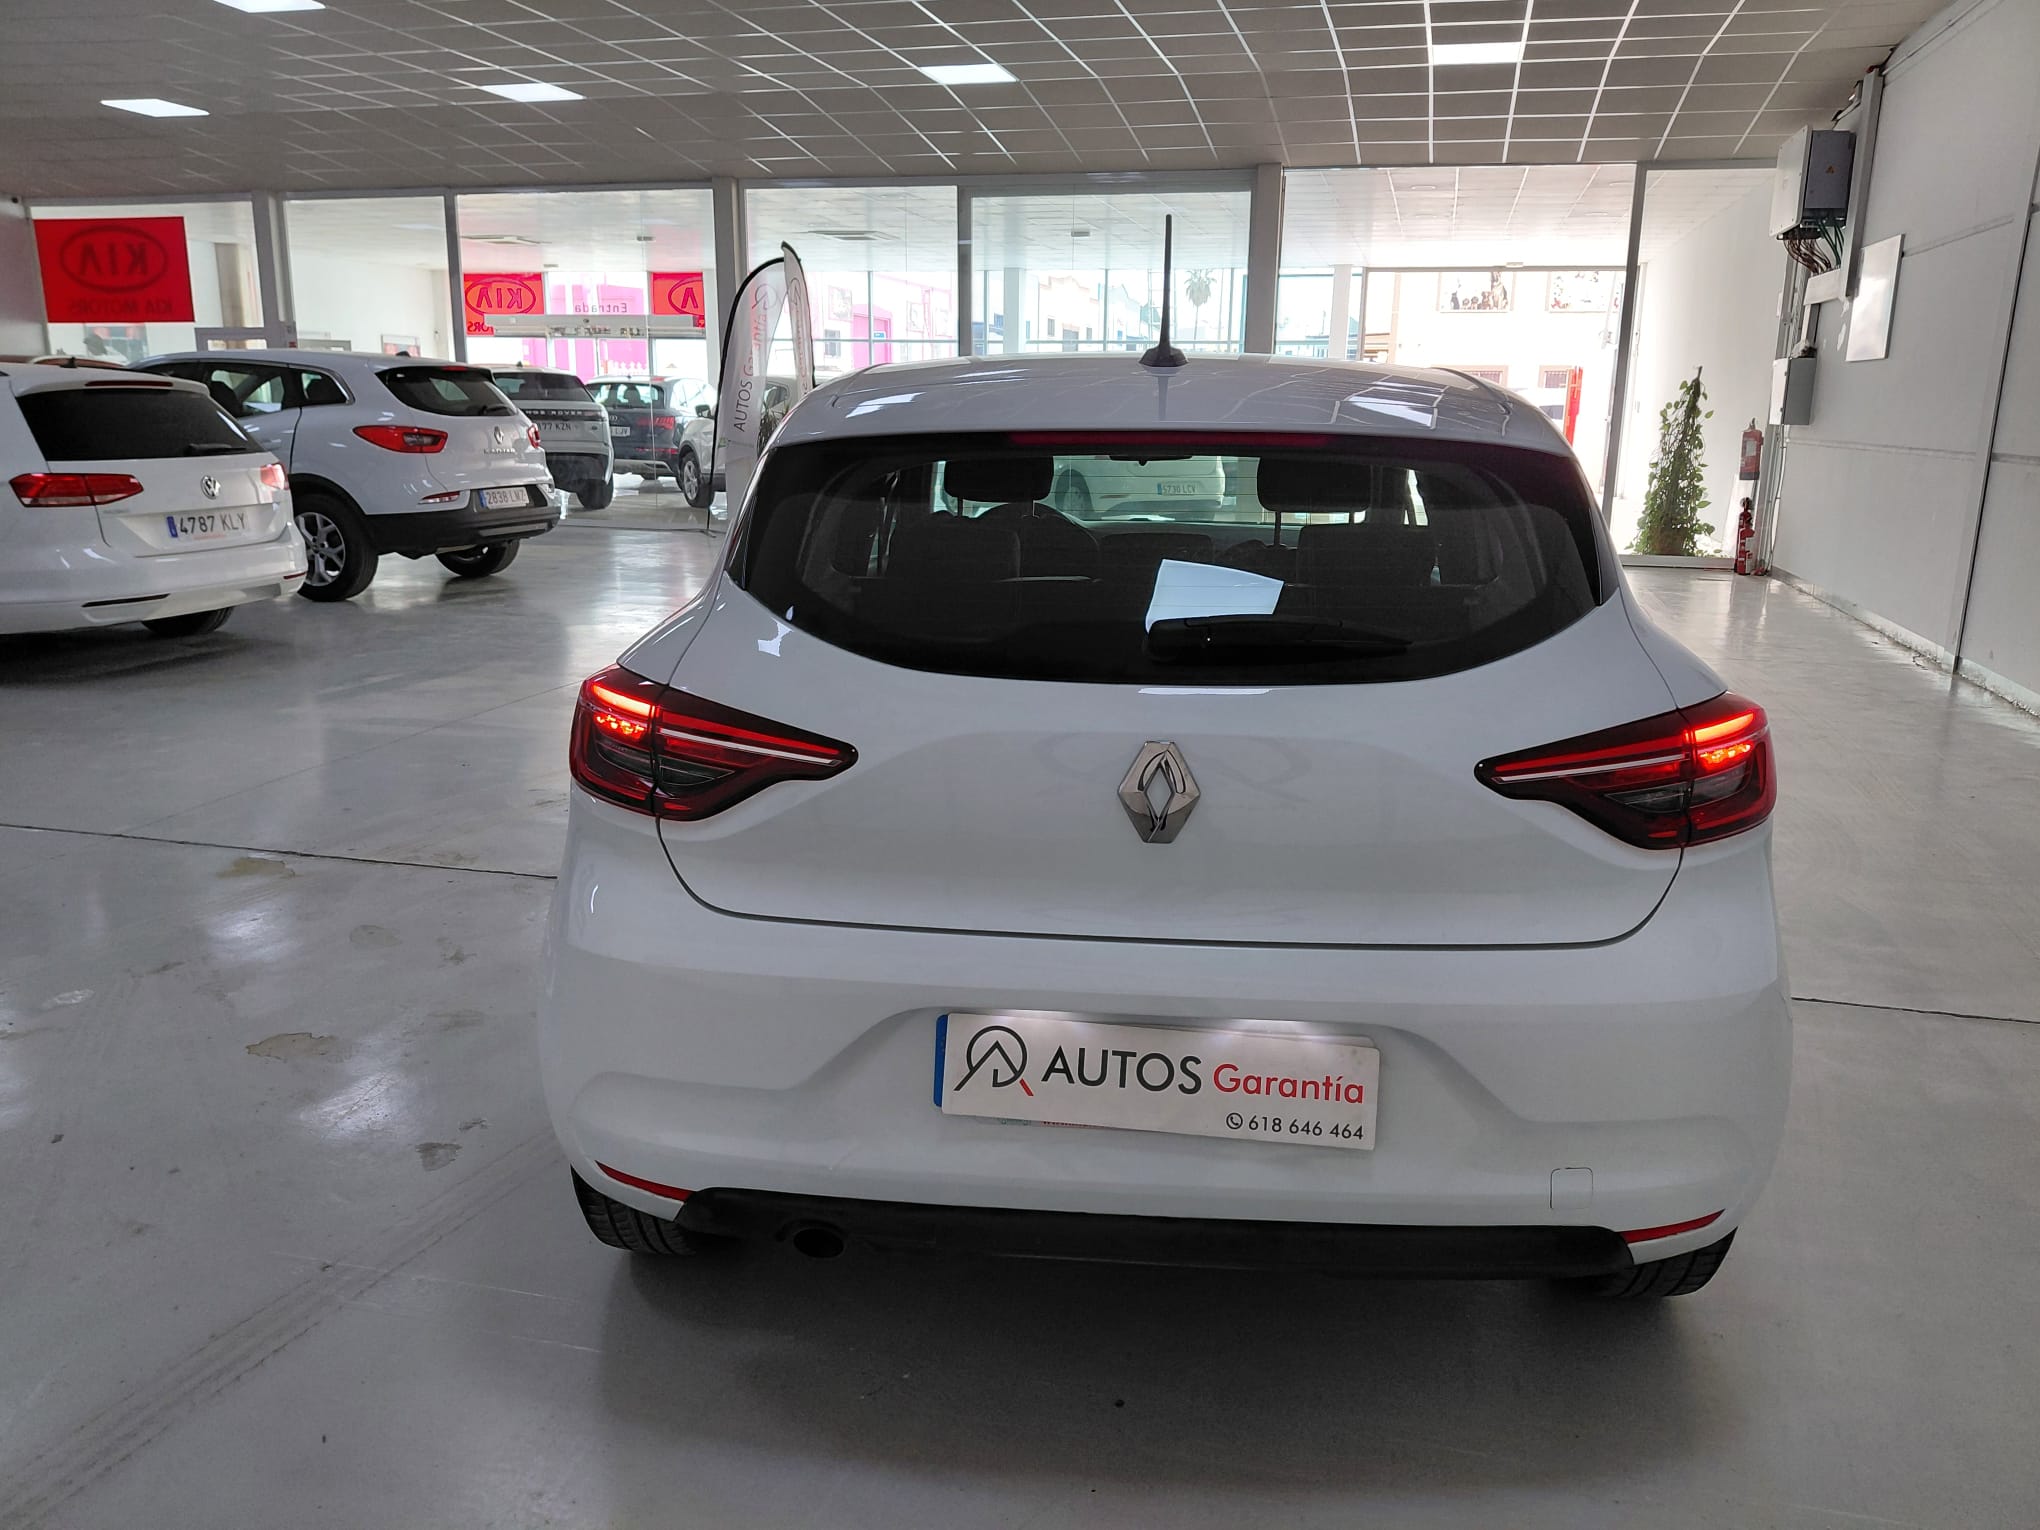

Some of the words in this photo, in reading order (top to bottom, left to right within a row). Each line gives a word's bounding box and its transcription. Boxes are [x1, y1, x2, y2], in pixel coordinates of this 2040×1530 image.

[734, 380, 753, 432] AUTOS
[486, 490, 509, 505] 2838
[180, 515, 215, 534] 4787
[220, 512, 245, 531] KLY
[1041, 1045, 1202, 1094] AUTOS
[1213, 1063, 1364, 1104] Garantía
[1248, 1115, 1282, 1132] 618
[1288, 1119, 1323, 1136] 646
[1329, 1123, 1364, 1140] 464
